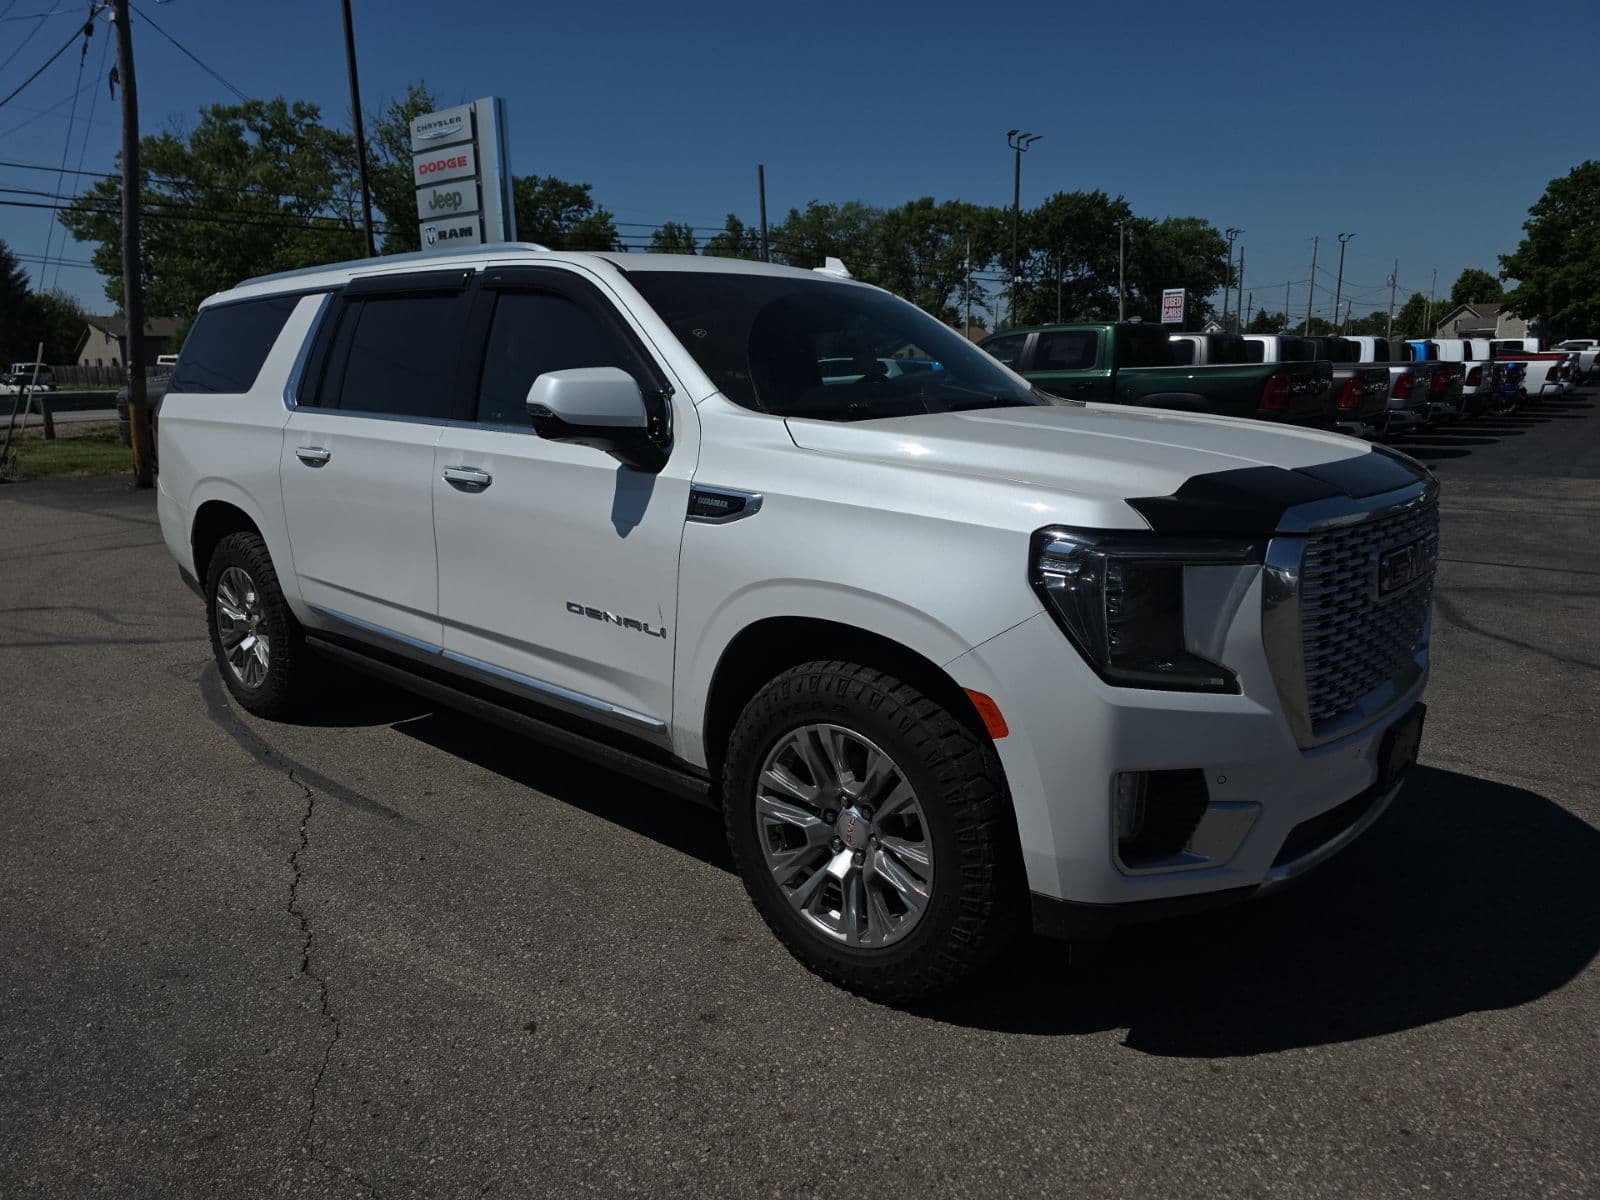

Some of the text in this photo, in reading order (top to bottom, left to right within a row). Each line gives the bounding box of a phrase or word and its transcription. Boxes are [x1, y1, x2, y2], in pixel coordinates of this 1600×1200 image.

[416, 116, 462, 133] CHRYSLER
[419, 156, 467, 175] DODGE
[429, 190, 462, 211] Jeep
[438, 227, 473, 240] RAM
[1164, 297, 1182, 306] USED
[1163, 307, 1181, 317] CARS
[566, 601, 667, 639] DENALI
